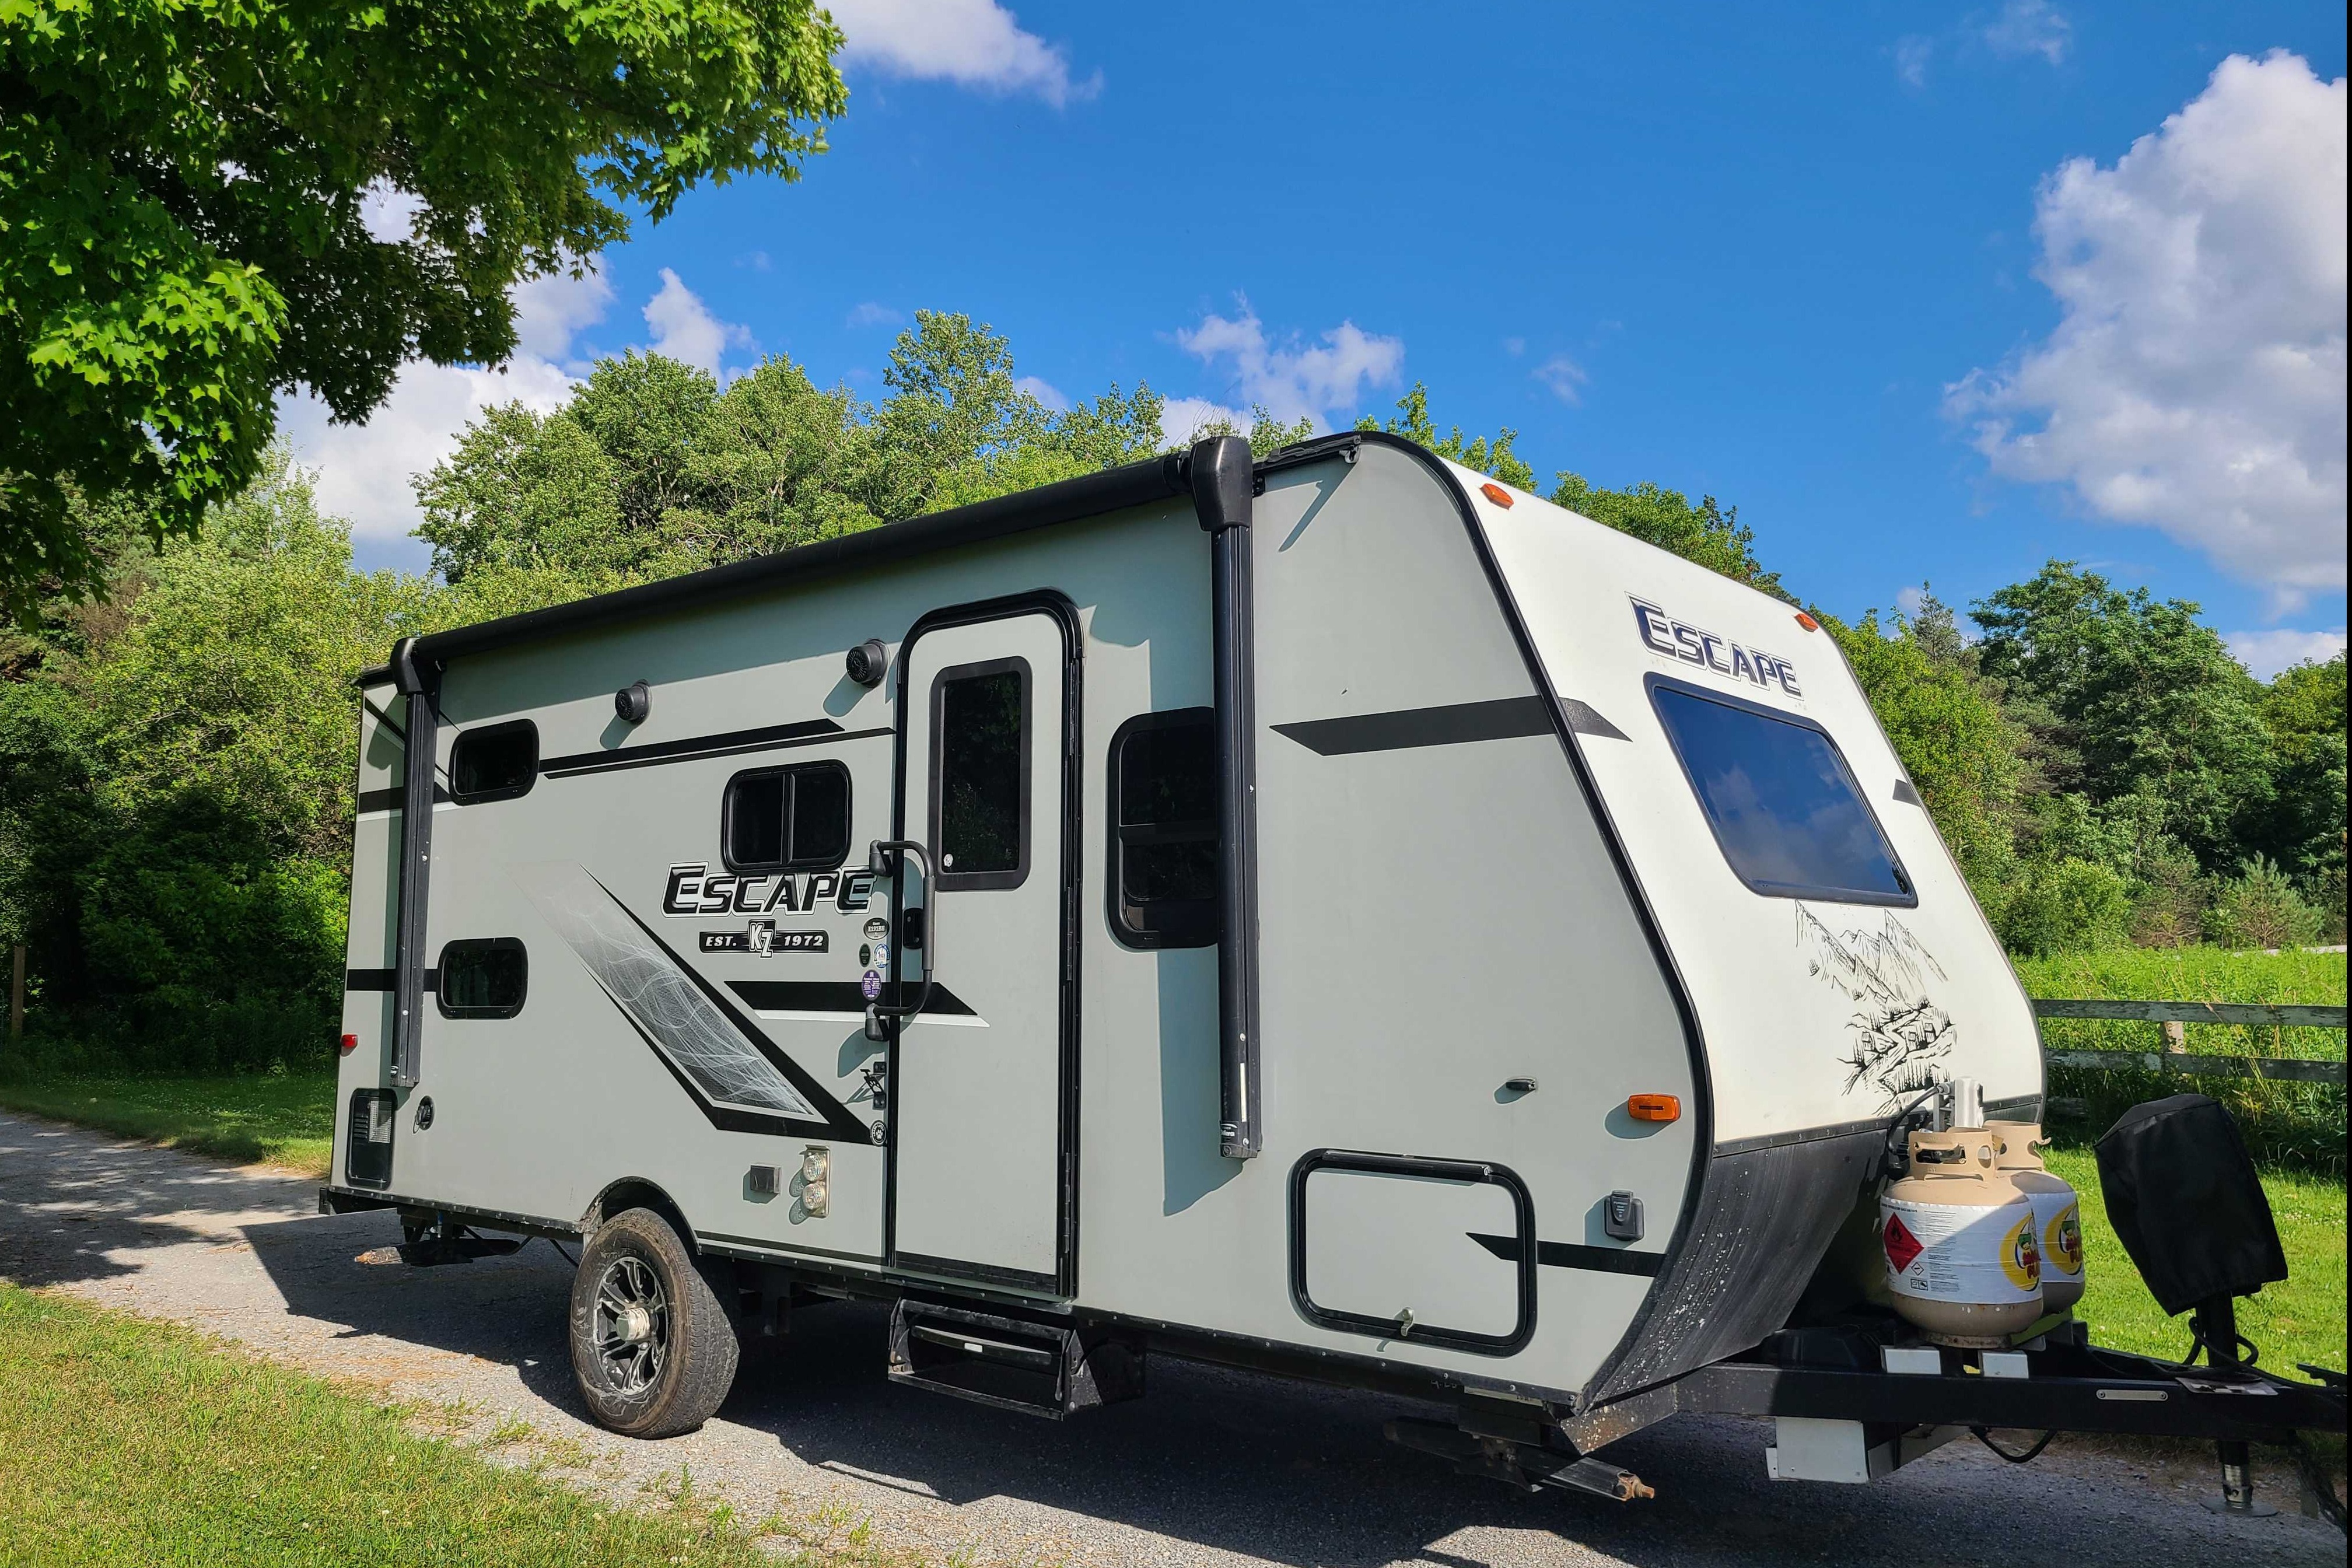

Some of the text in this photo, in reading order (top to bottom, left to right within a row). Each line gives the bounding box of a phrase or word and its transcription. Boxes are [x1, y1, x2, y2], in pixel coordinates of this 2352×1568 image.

[1626, 592, 1804, 701] ESCAPE
[705, 935, 824, 947] EST. 1972
[749, 922, 773, 959] KZ
